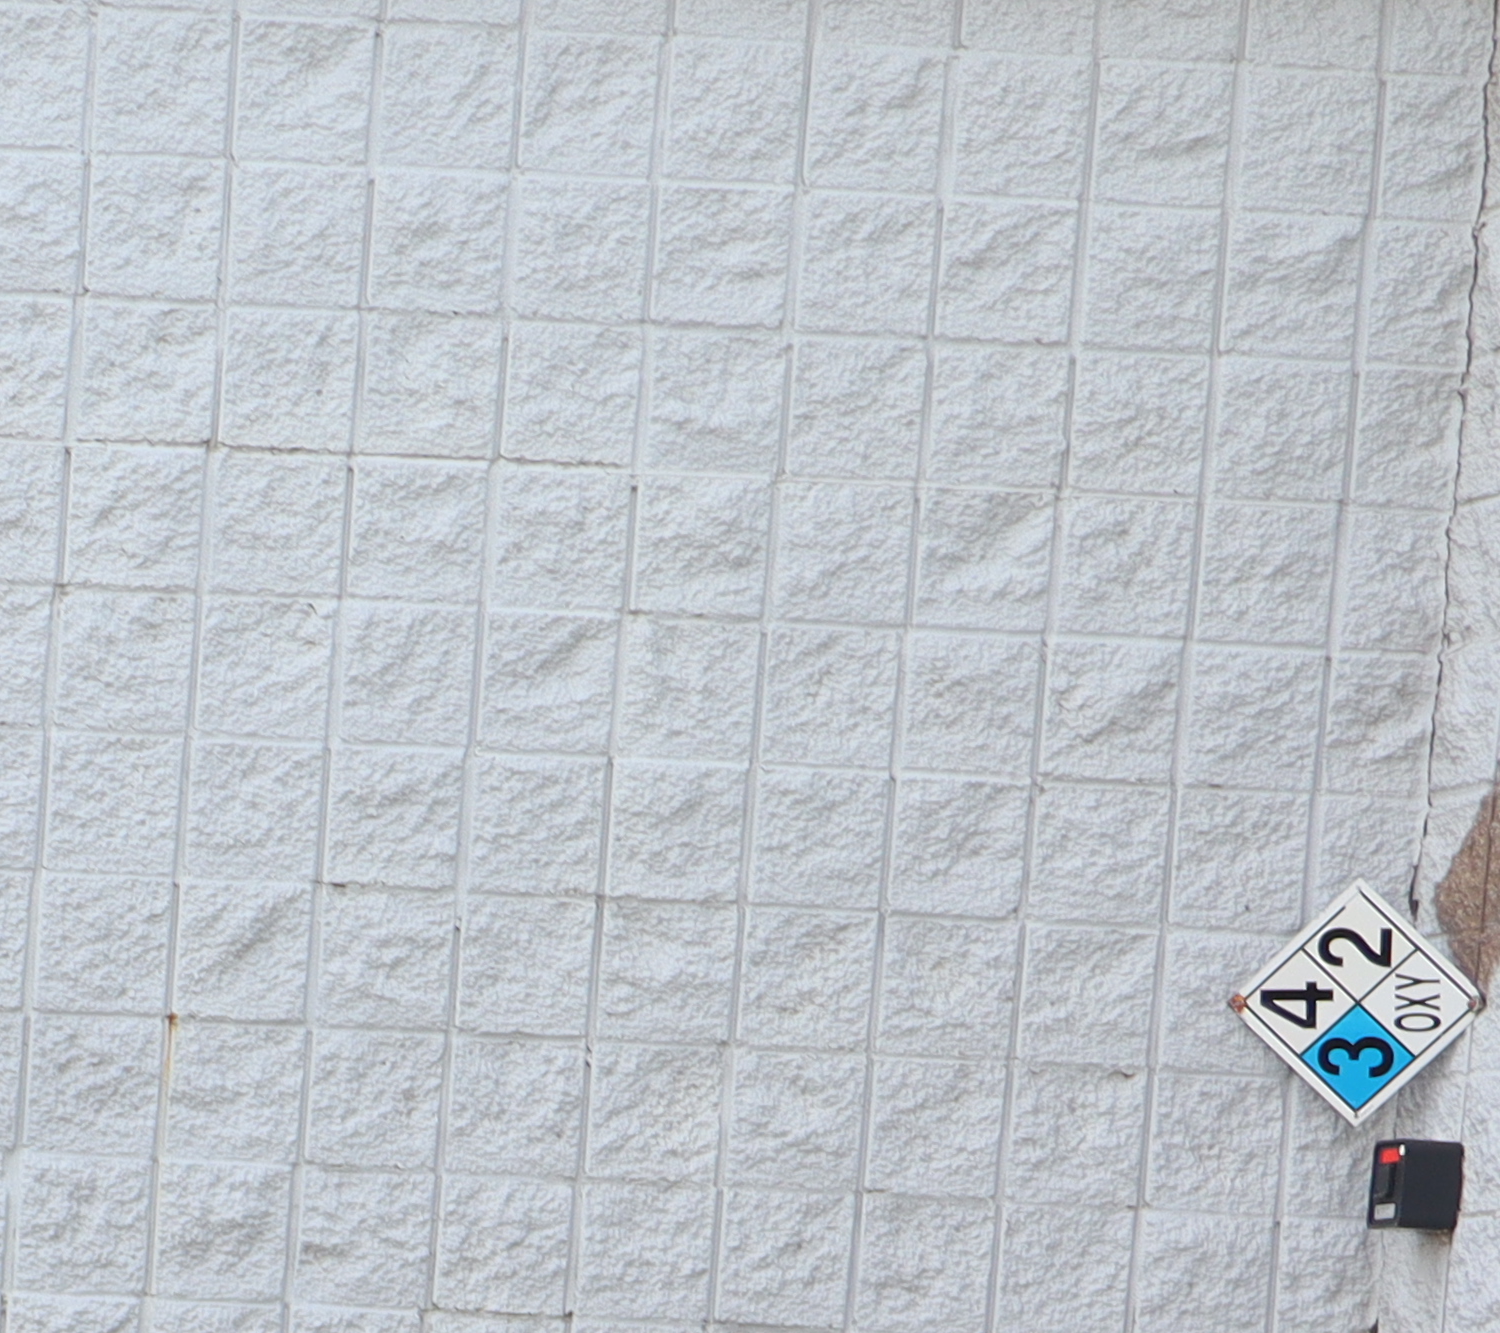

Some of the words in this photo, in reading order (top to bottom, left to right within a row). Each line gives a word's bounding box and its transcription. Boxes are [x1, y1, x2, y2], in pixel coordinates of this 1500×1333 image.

[1318, 927, 1393, 967] 2
[1260, 981, 1334, 1030] 4
[1393, 973, 1442, 1032] OXY
[1317, 1036, 1395, 1078] 3
